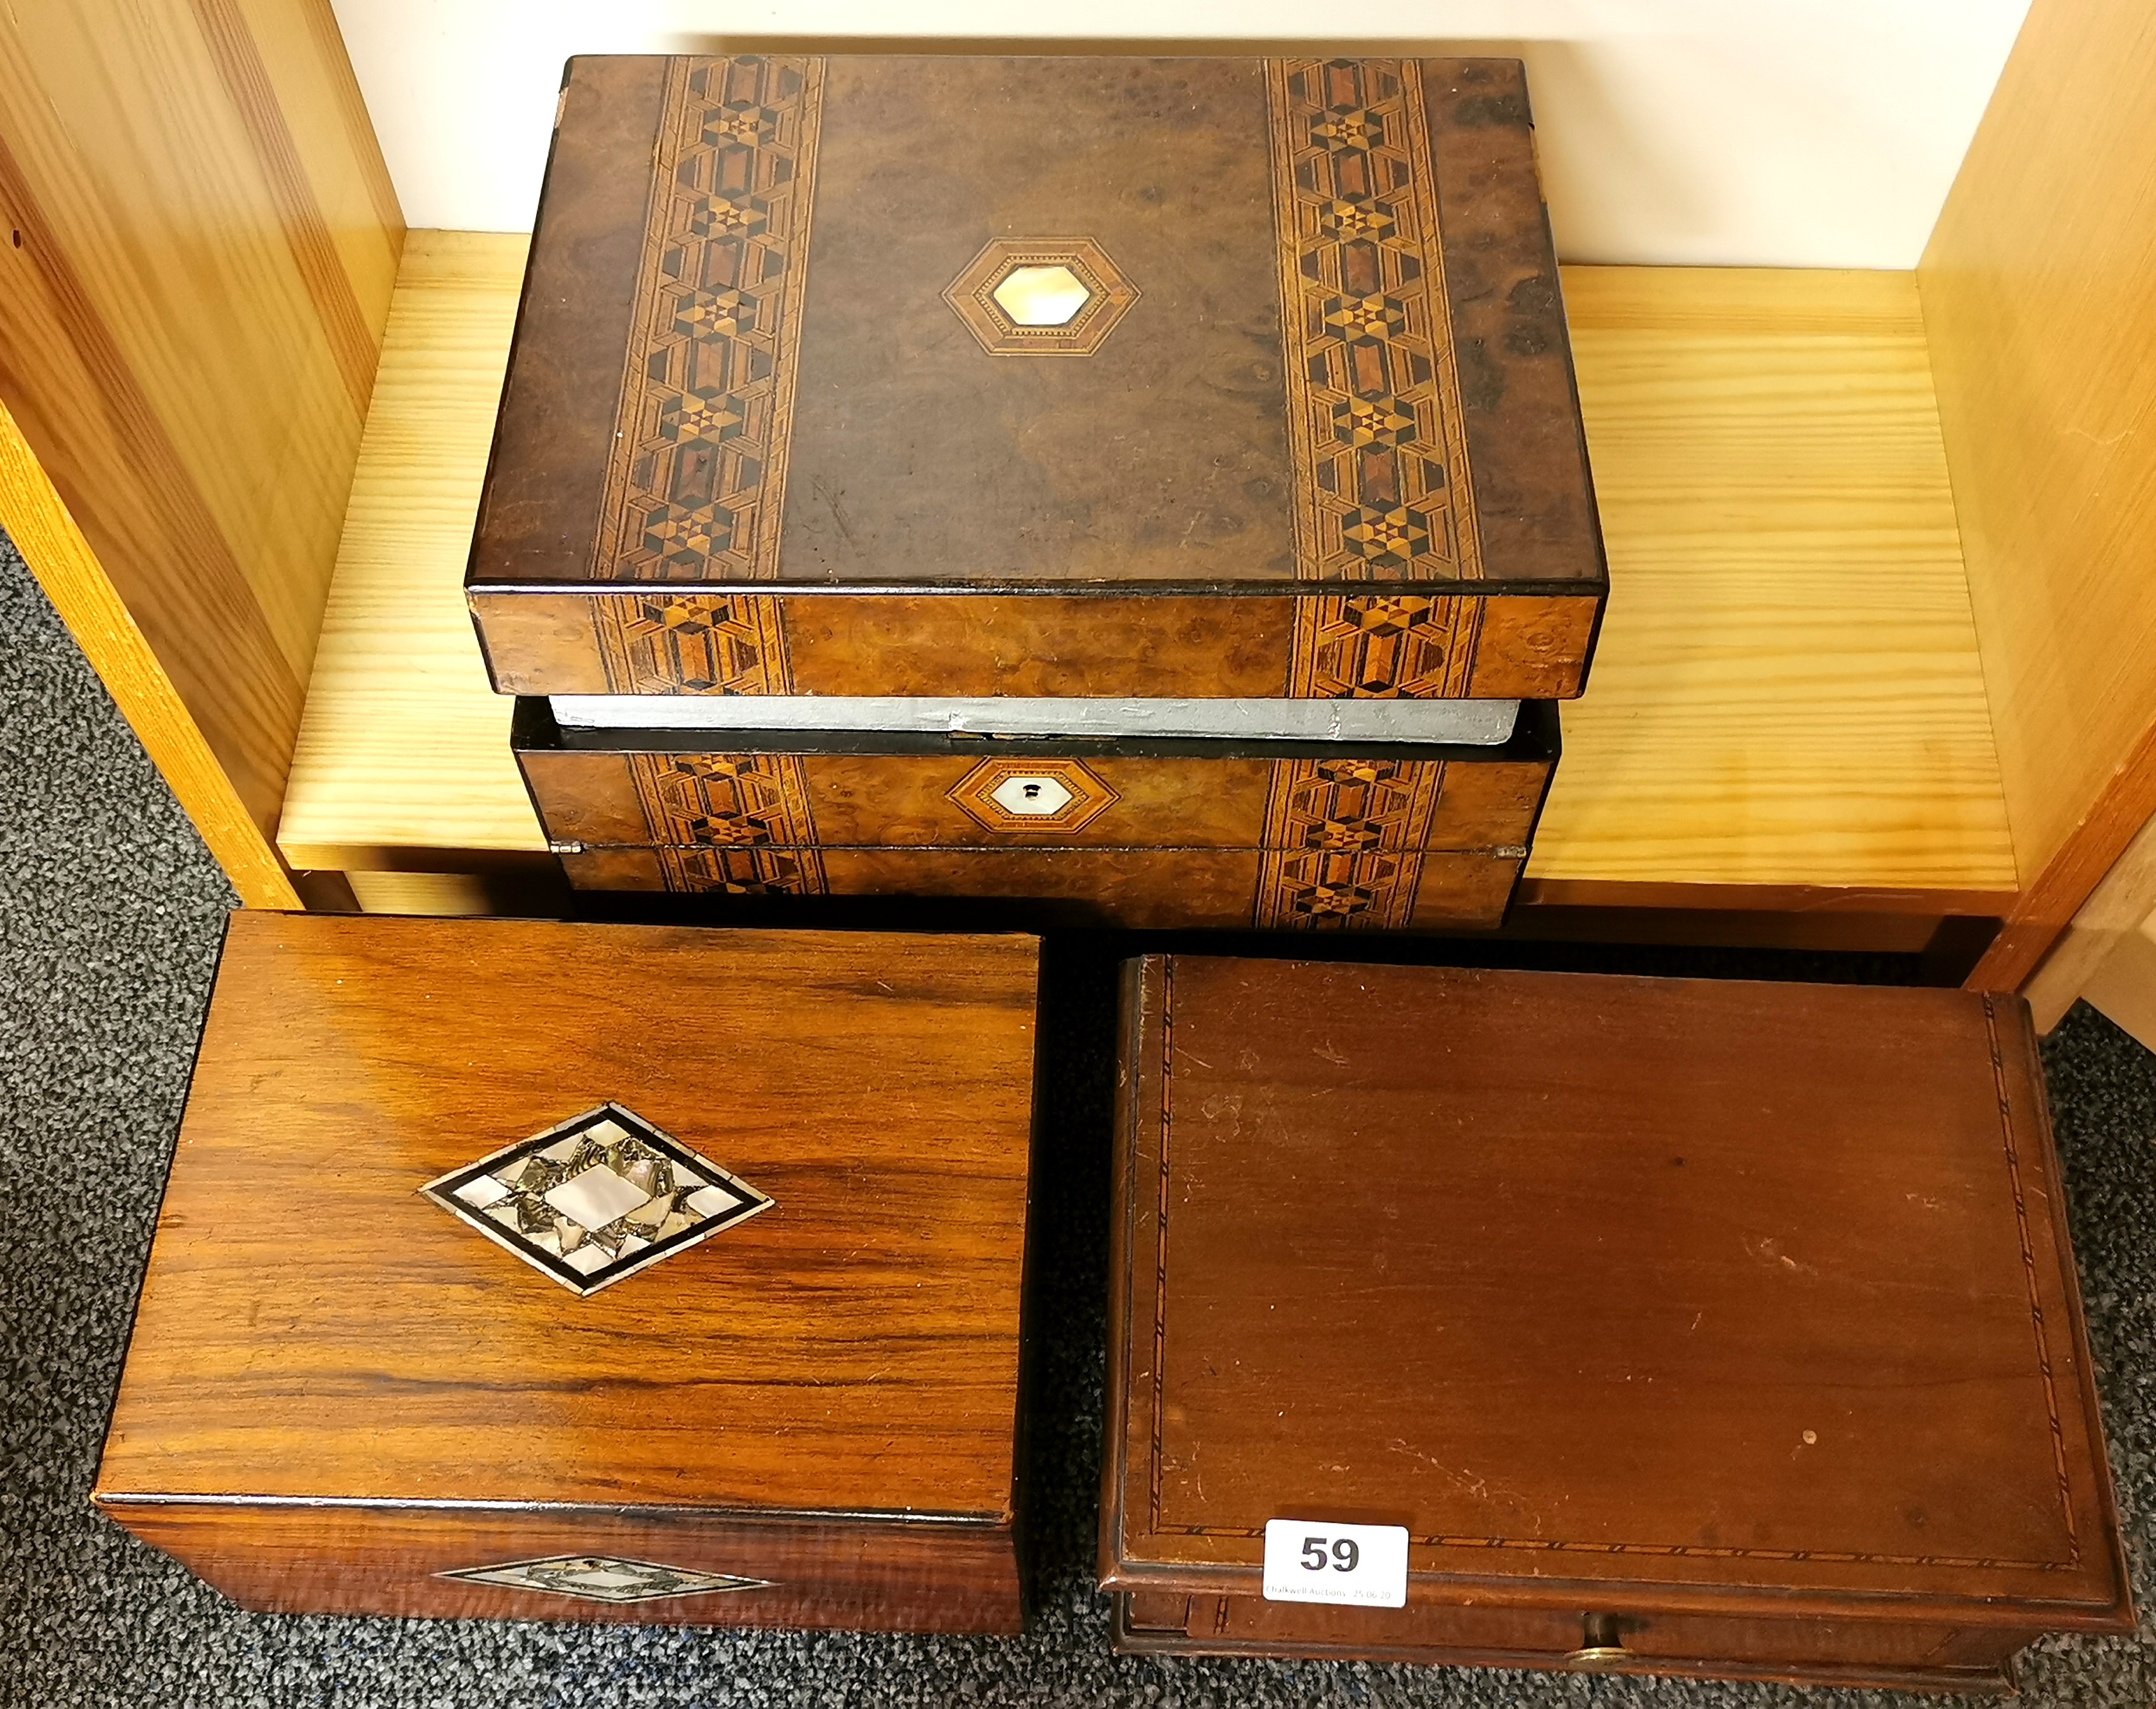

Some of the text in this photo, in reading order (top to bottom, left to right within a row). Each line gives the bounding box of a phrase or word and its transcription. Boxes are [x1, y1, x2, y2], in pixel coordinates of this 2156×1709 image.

[1300, 1536, 1360, 1572] 59
[1266, 1584, 1307, 1594] Chalkwell
[1309, 1587, 1346, 1597] Auctions
